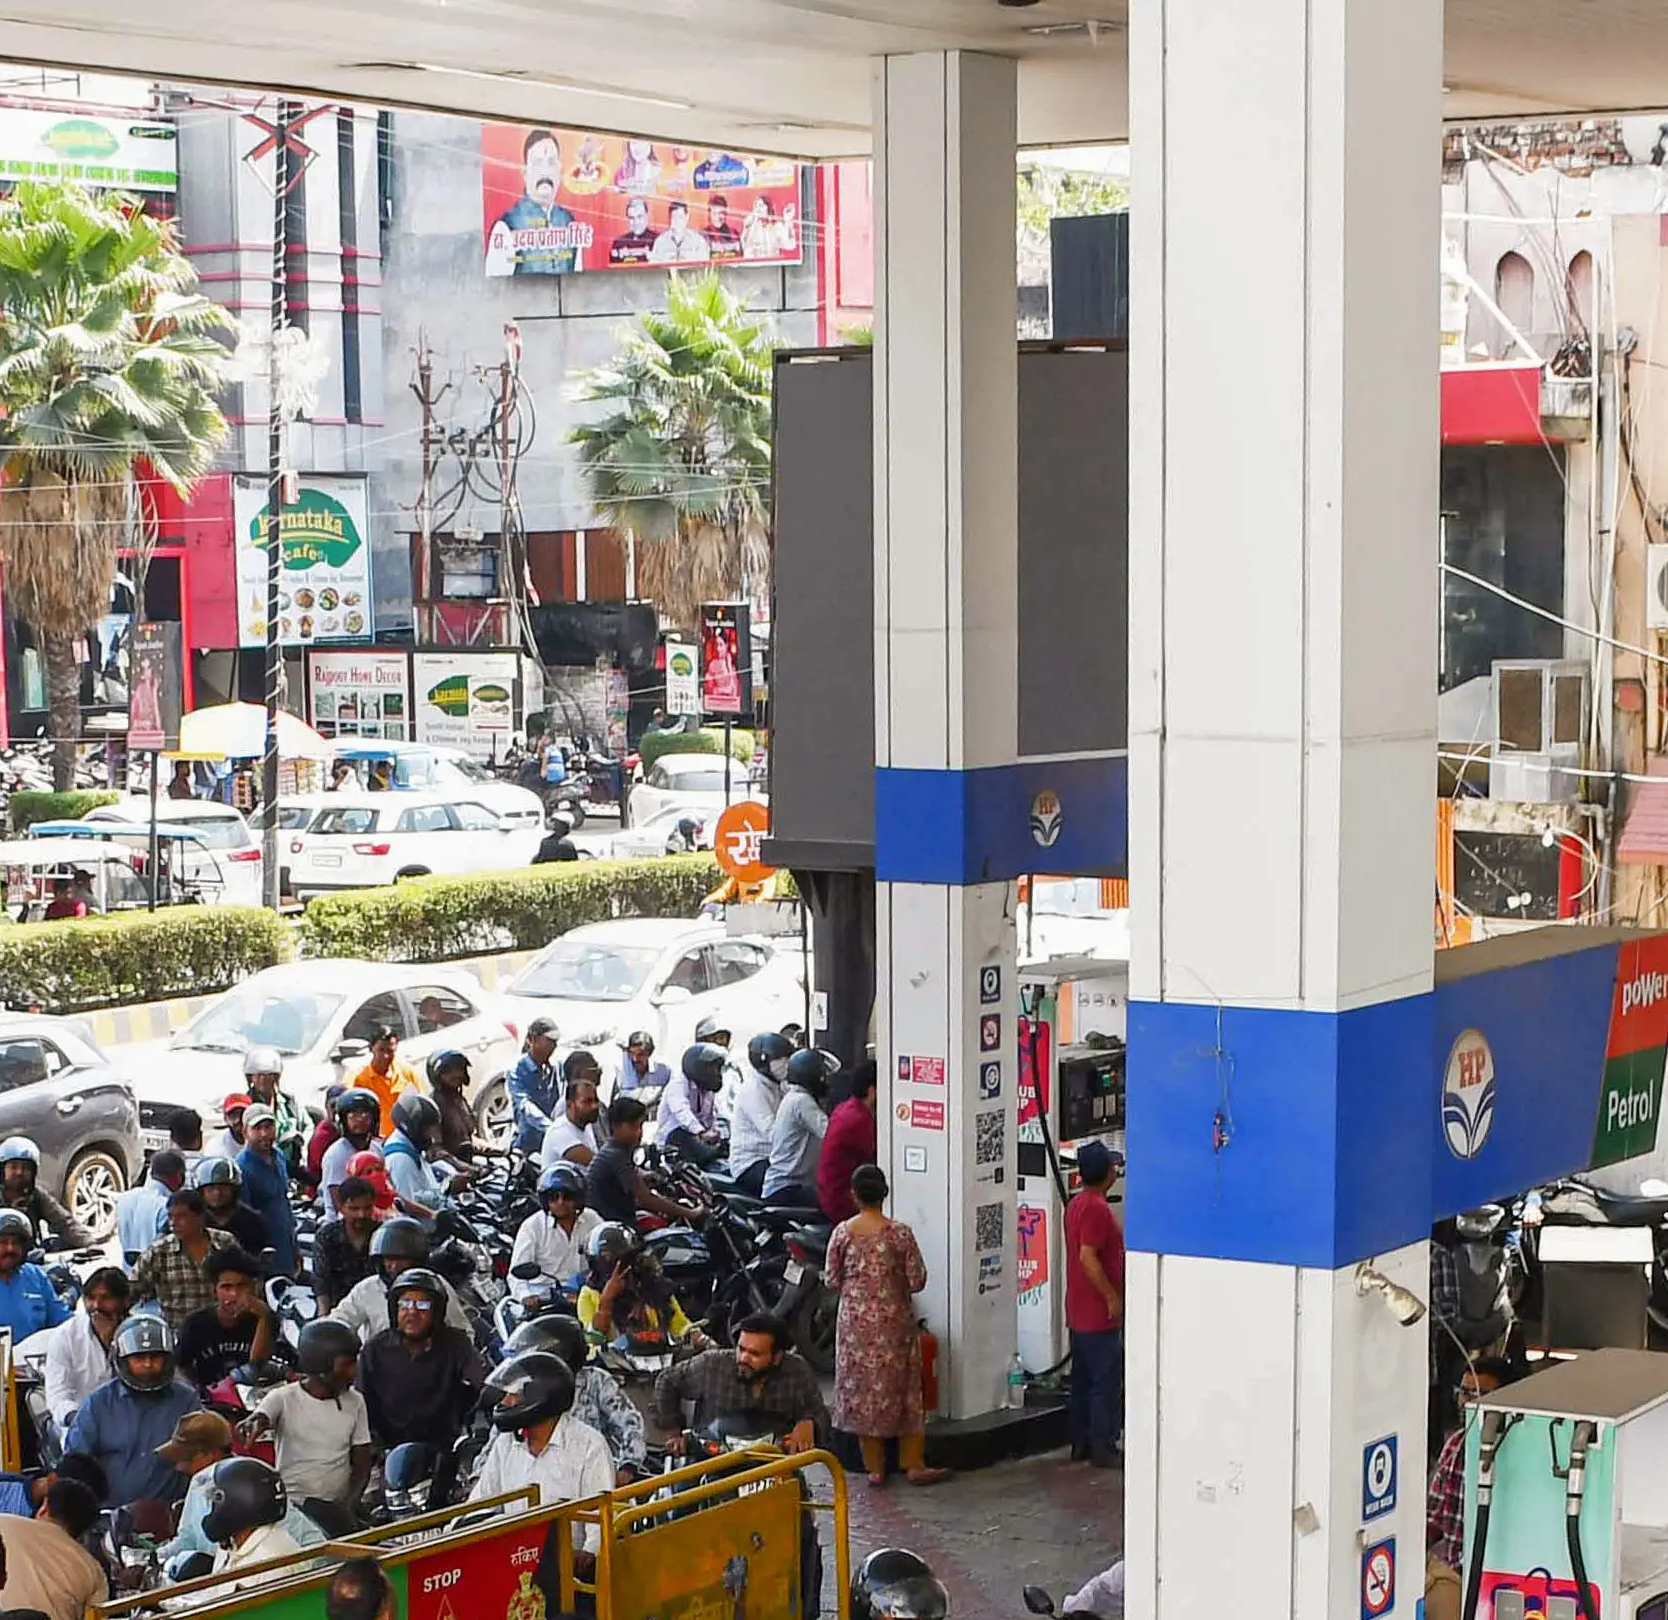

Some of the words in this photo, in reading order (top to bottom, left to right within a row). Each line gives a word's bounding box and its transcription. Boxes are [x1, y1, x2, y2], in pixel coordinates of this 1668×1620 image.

[257, 509, 344, 537] krnataka
[1458, 1044, 1488, 1090] HP
[1606, 1078, 1655, 1132] Petrol
[423, 1568, 462, 1593] STOP
